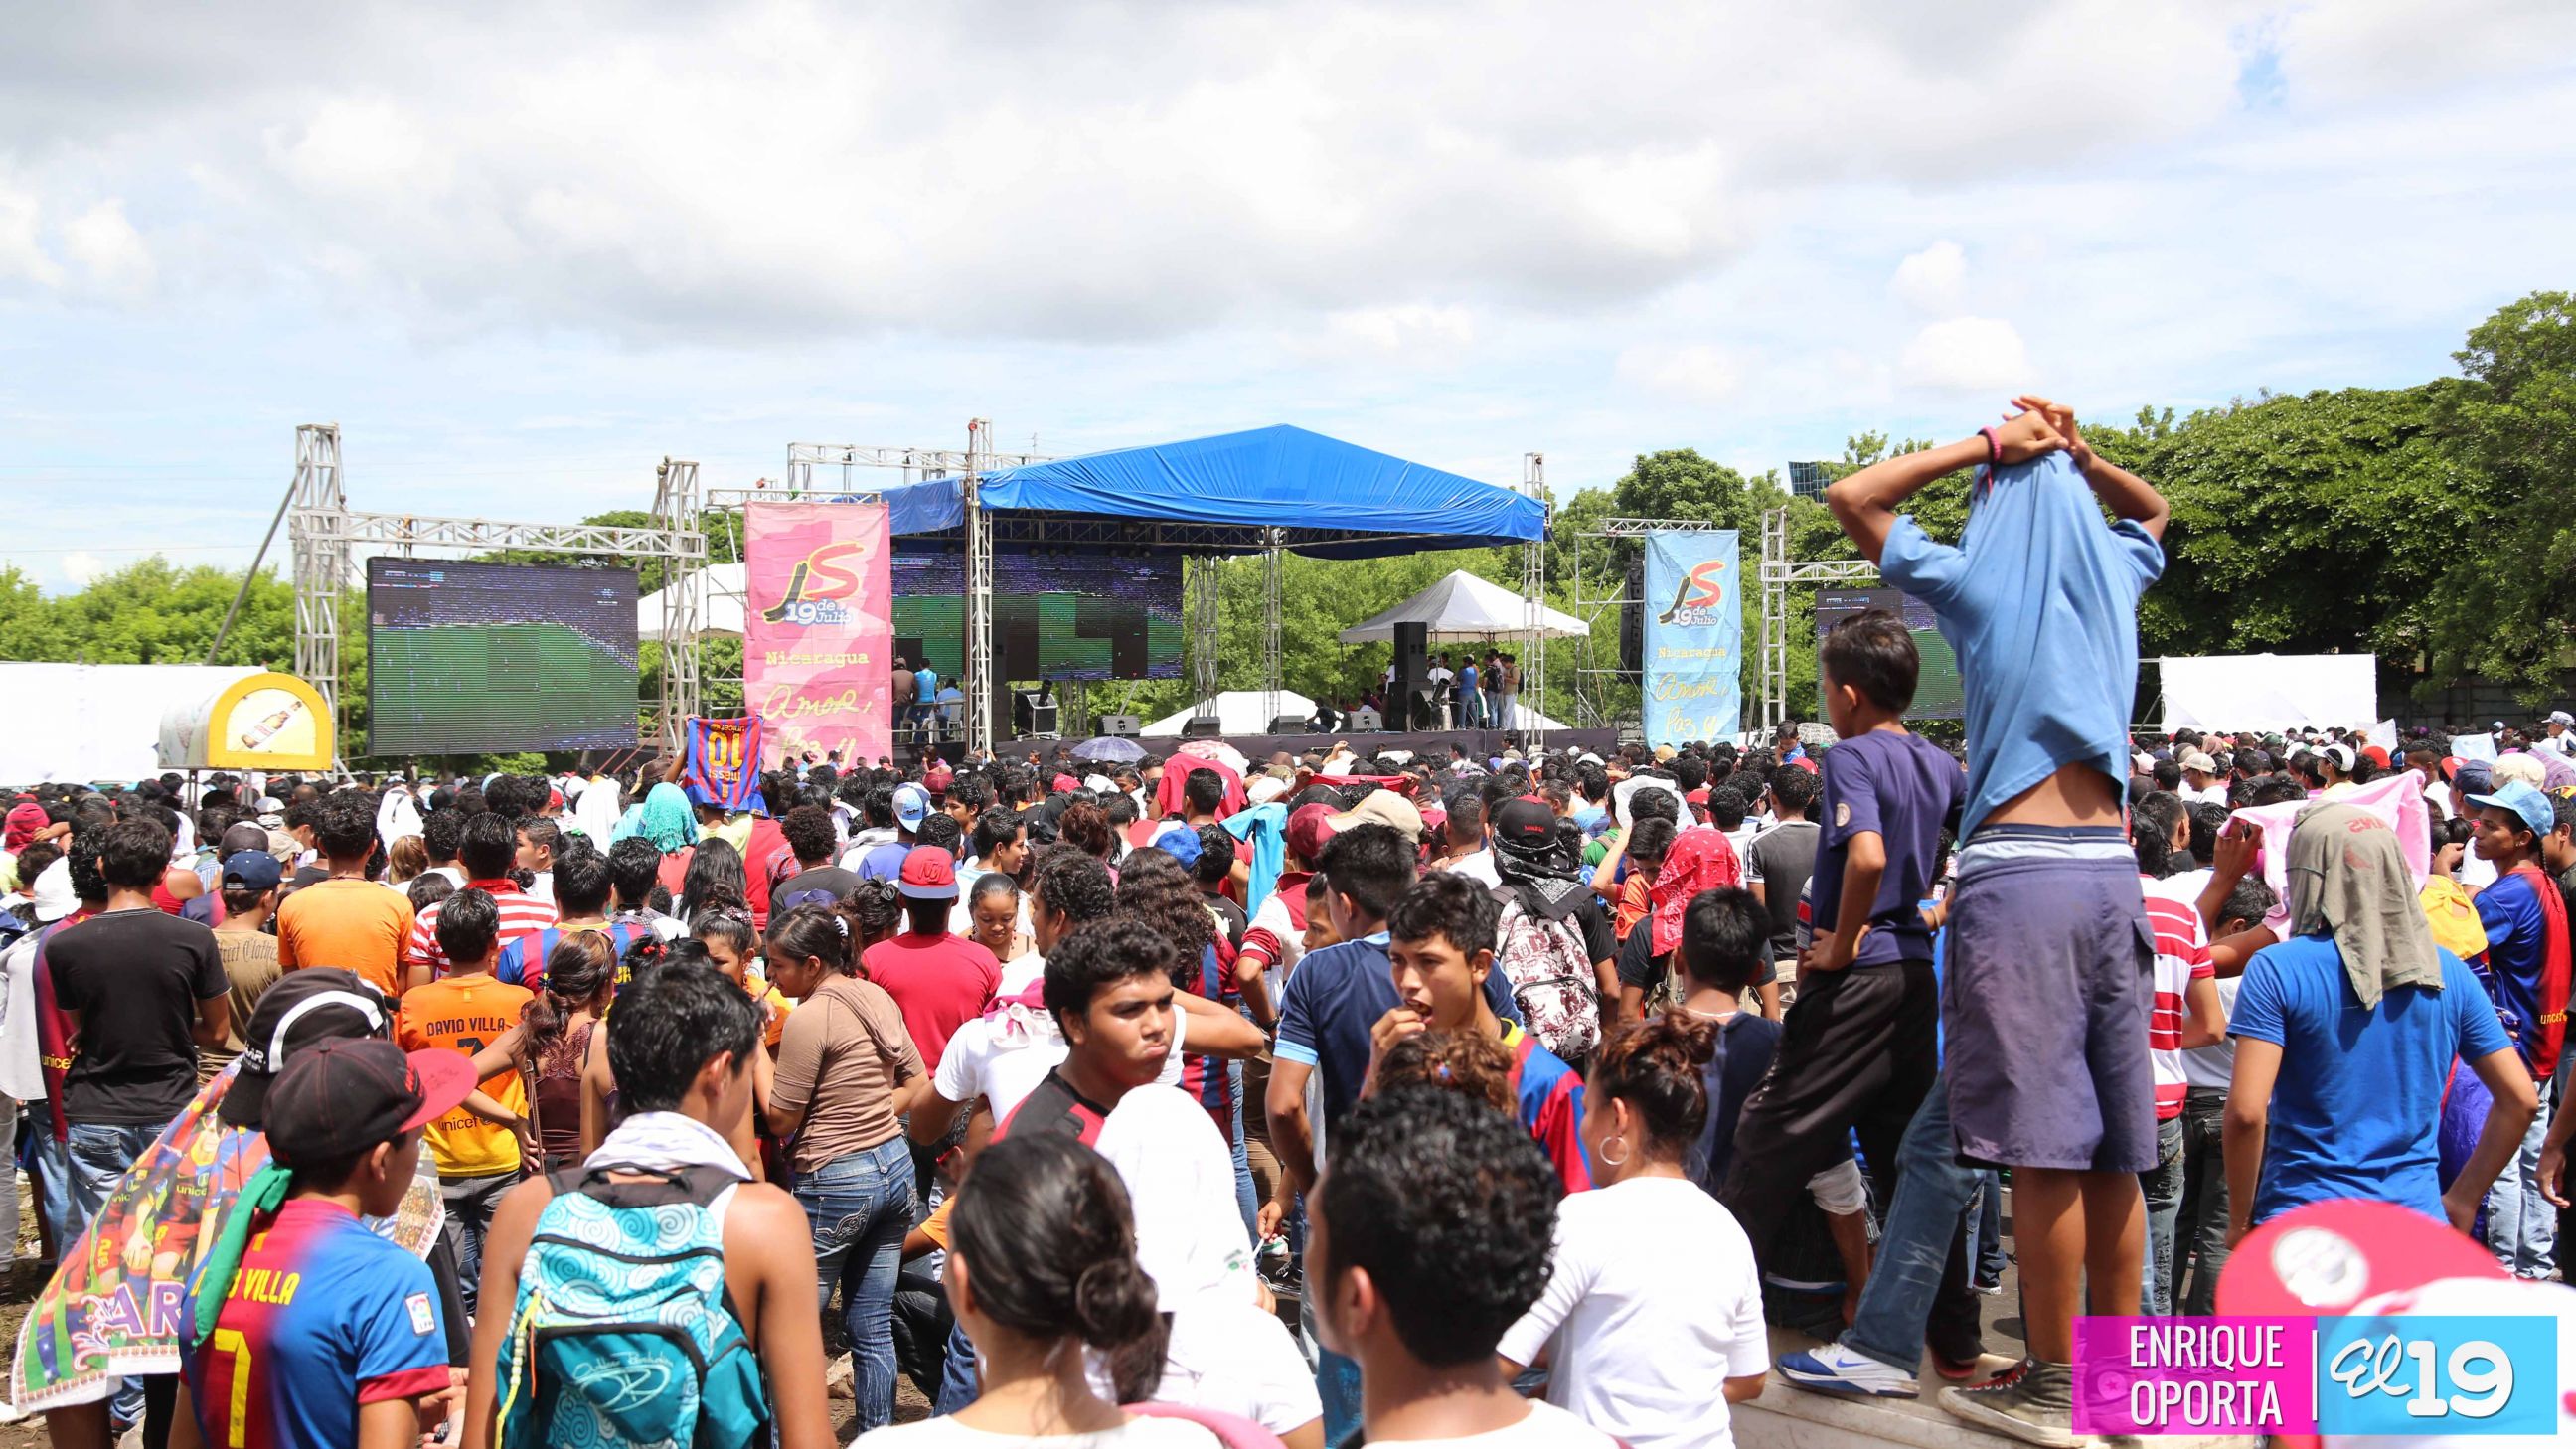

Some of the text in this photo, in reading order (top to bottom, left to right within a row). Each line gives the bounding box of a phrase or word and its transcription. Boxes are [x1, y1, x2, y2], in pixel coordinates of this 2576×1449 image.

[785, 598, 853, 625] 19 de Julio
[1673, 605, 1716, 626] 19 de Julio
[765, 651, 870, 668] Nicaragua
[1658, 646, 1725, 661] Nicaragua
[708, 731, 743, 768] 10
[426, 1017, 505, 1036] DAVID VILLA
[41, 1053, 76, 1070] unice
[438, 1116, 477, 1131] unicef
[243, 1267, 300, 1305] VILLA
[214, 1328, 251, 1448] 7
